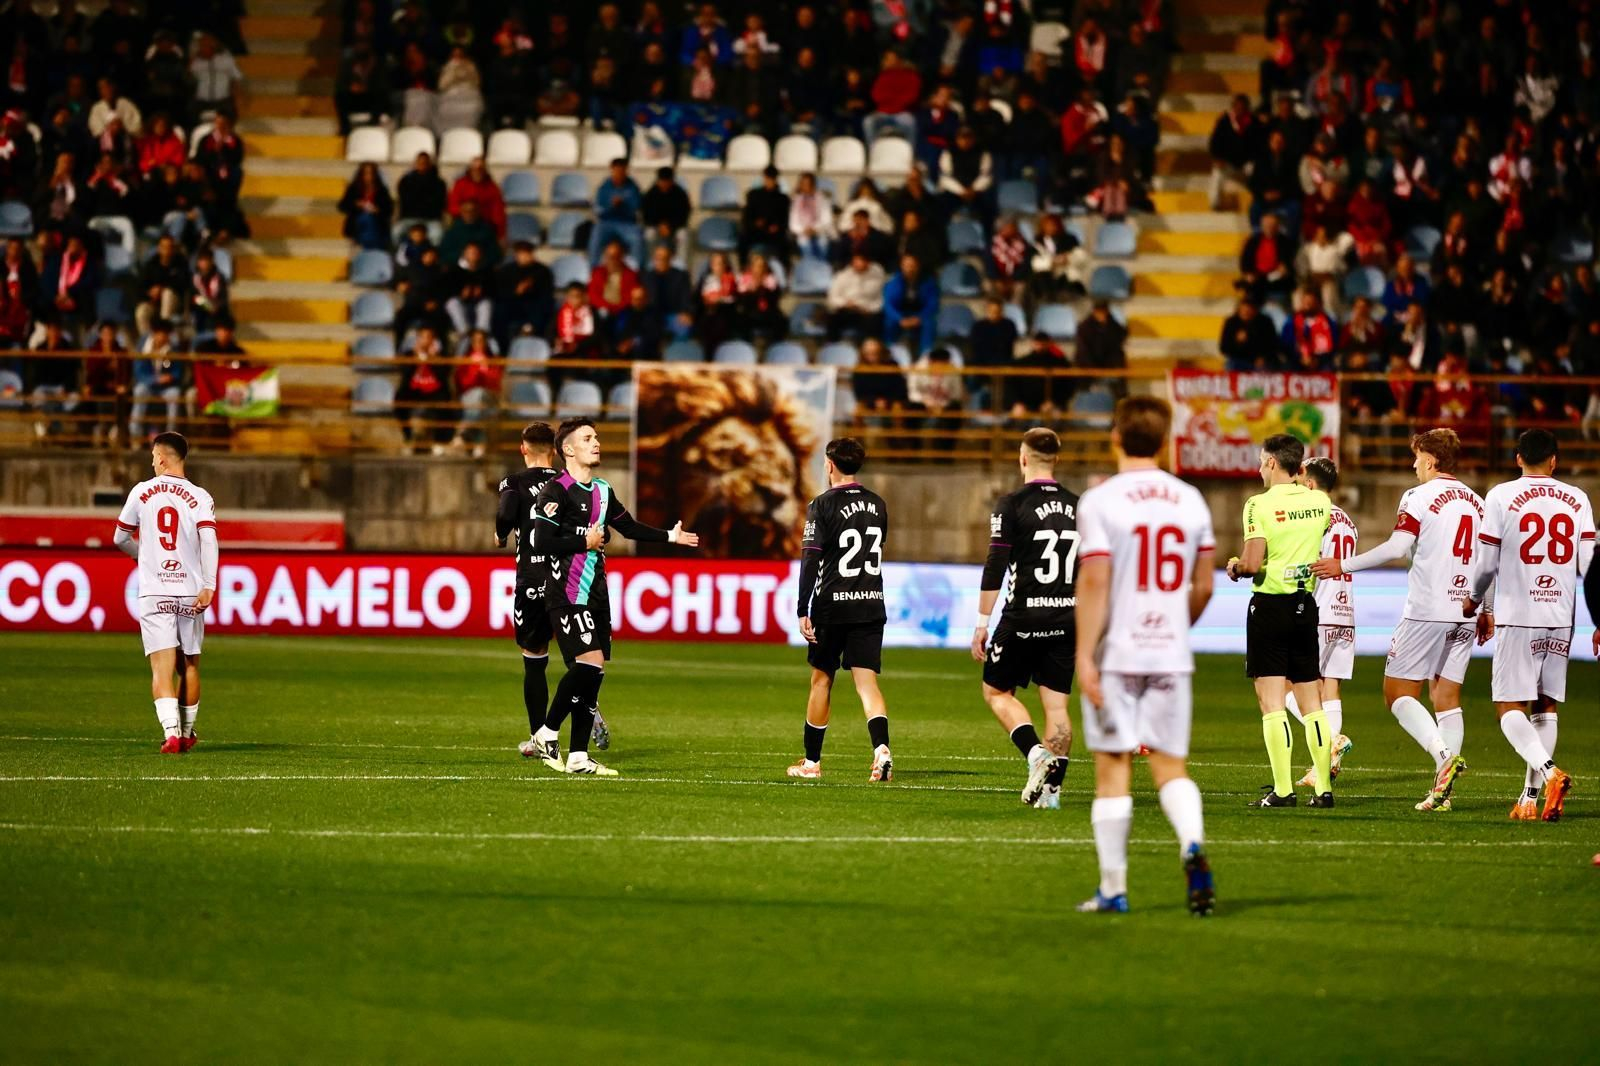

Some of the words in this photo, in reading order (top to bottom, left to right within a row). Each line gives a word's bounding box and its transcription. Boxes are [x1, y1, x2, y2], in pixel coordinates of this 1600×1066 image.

[139, 484, 168, 504] MANU
[169, 485, 198, 509] JUSTO
[840, 500, 866, 519] IZAN
[866, 502, 879, 516] M.
[1429, 489, 1458, 514] RODRI
[1508, 487, 1547, 513] THIAGO
[1548, 488, 1583, 513] OJEDA
[1035, 501, 1063, 521] RAFA
[1064, 504, 1076, 520] R.
[1288, 508, 1324, 520] WÜRTH
[157, 506, 179, 551] 9
[1453, 514, 1473, 565] 4
[1519, 512, 1574, 565] 28
[838, 527, 883, 578] 23
[1033, 530, 1082, 584] 37
[1131, 523, 1186, 592] 16
[125, 565, 471, 628] RAMELO
[1529, 589, 1562, 597] HYUNDAI
[573, 610, 596, 633] 16
